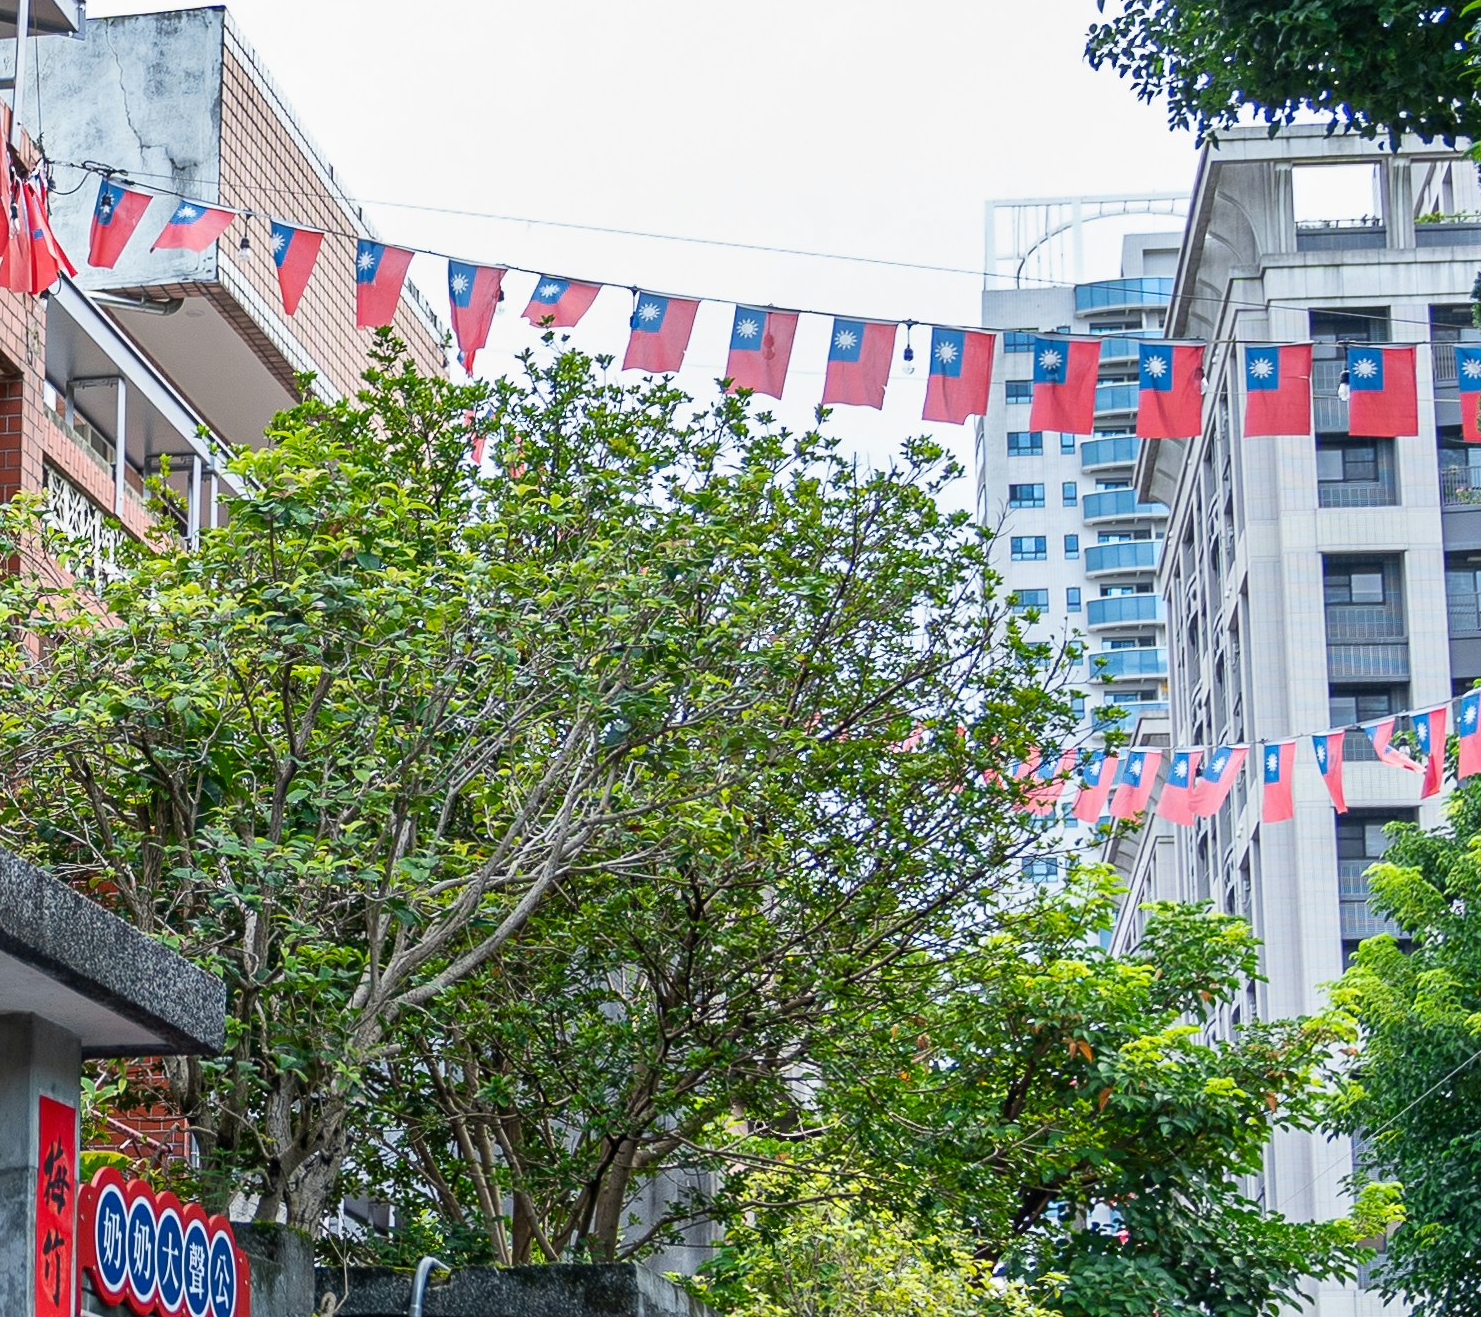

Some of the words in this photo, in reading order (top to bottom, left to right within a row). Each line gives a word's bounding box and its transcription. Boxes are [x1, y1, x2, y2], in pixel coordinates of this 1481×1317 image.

[103, 1207, 230, 1310] 奶奶大聲公
